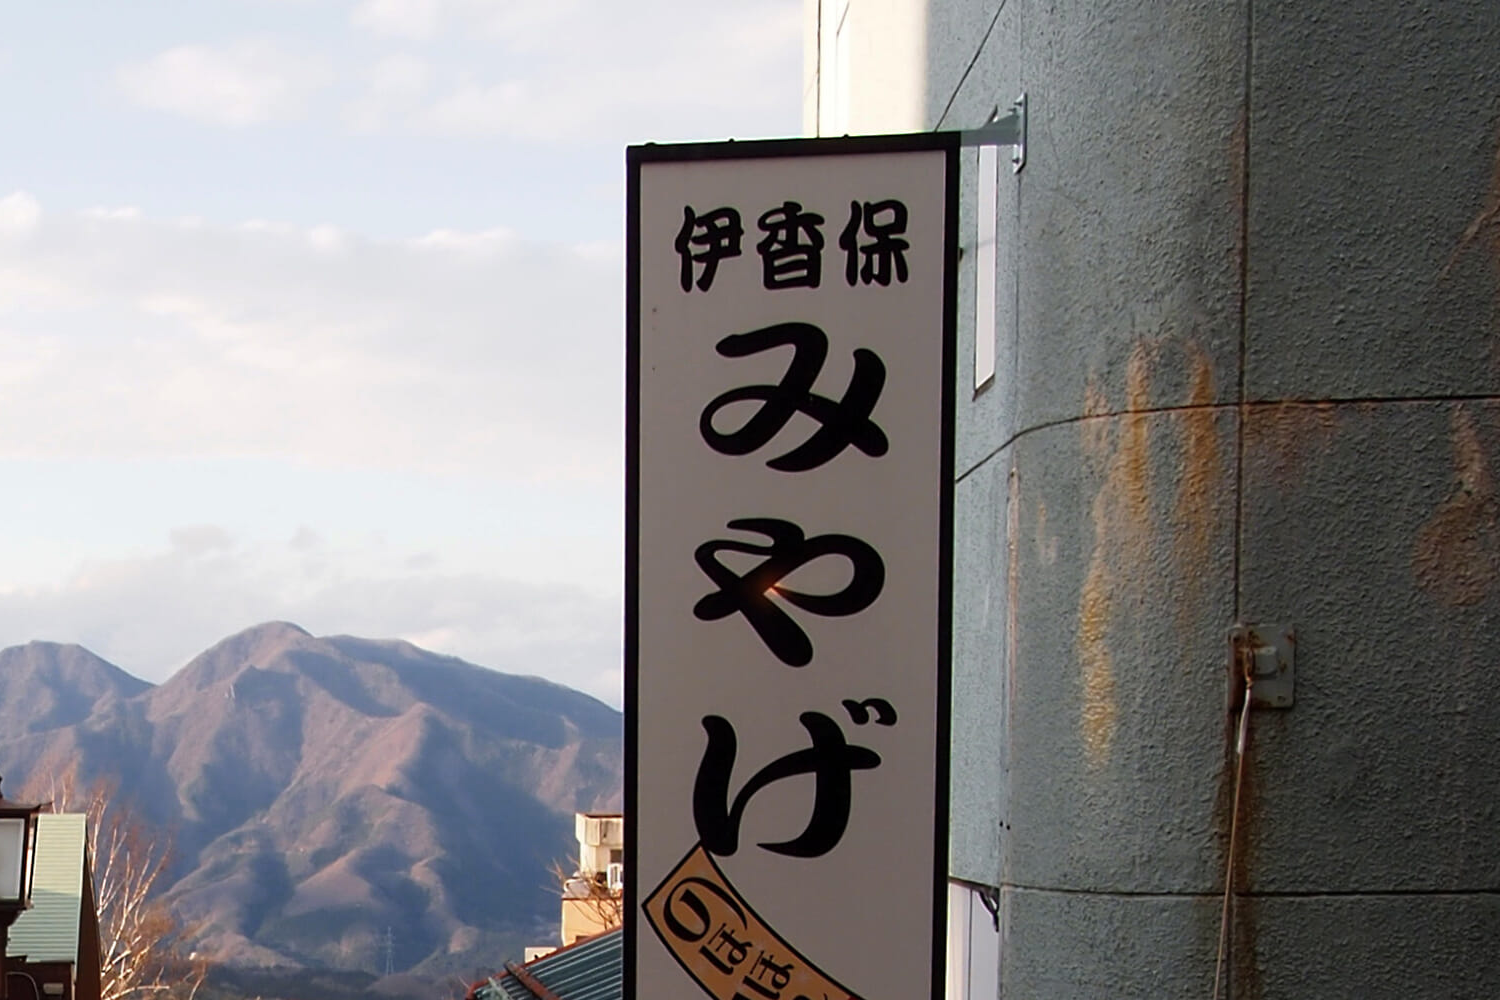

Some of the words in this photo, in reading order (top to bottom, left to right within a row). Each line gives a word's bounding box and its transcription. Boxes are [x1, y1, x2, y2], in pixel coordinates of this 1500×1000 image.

[674, 199, 912, 294] 伊香保
[692, 320, 899, 858] みやげ
